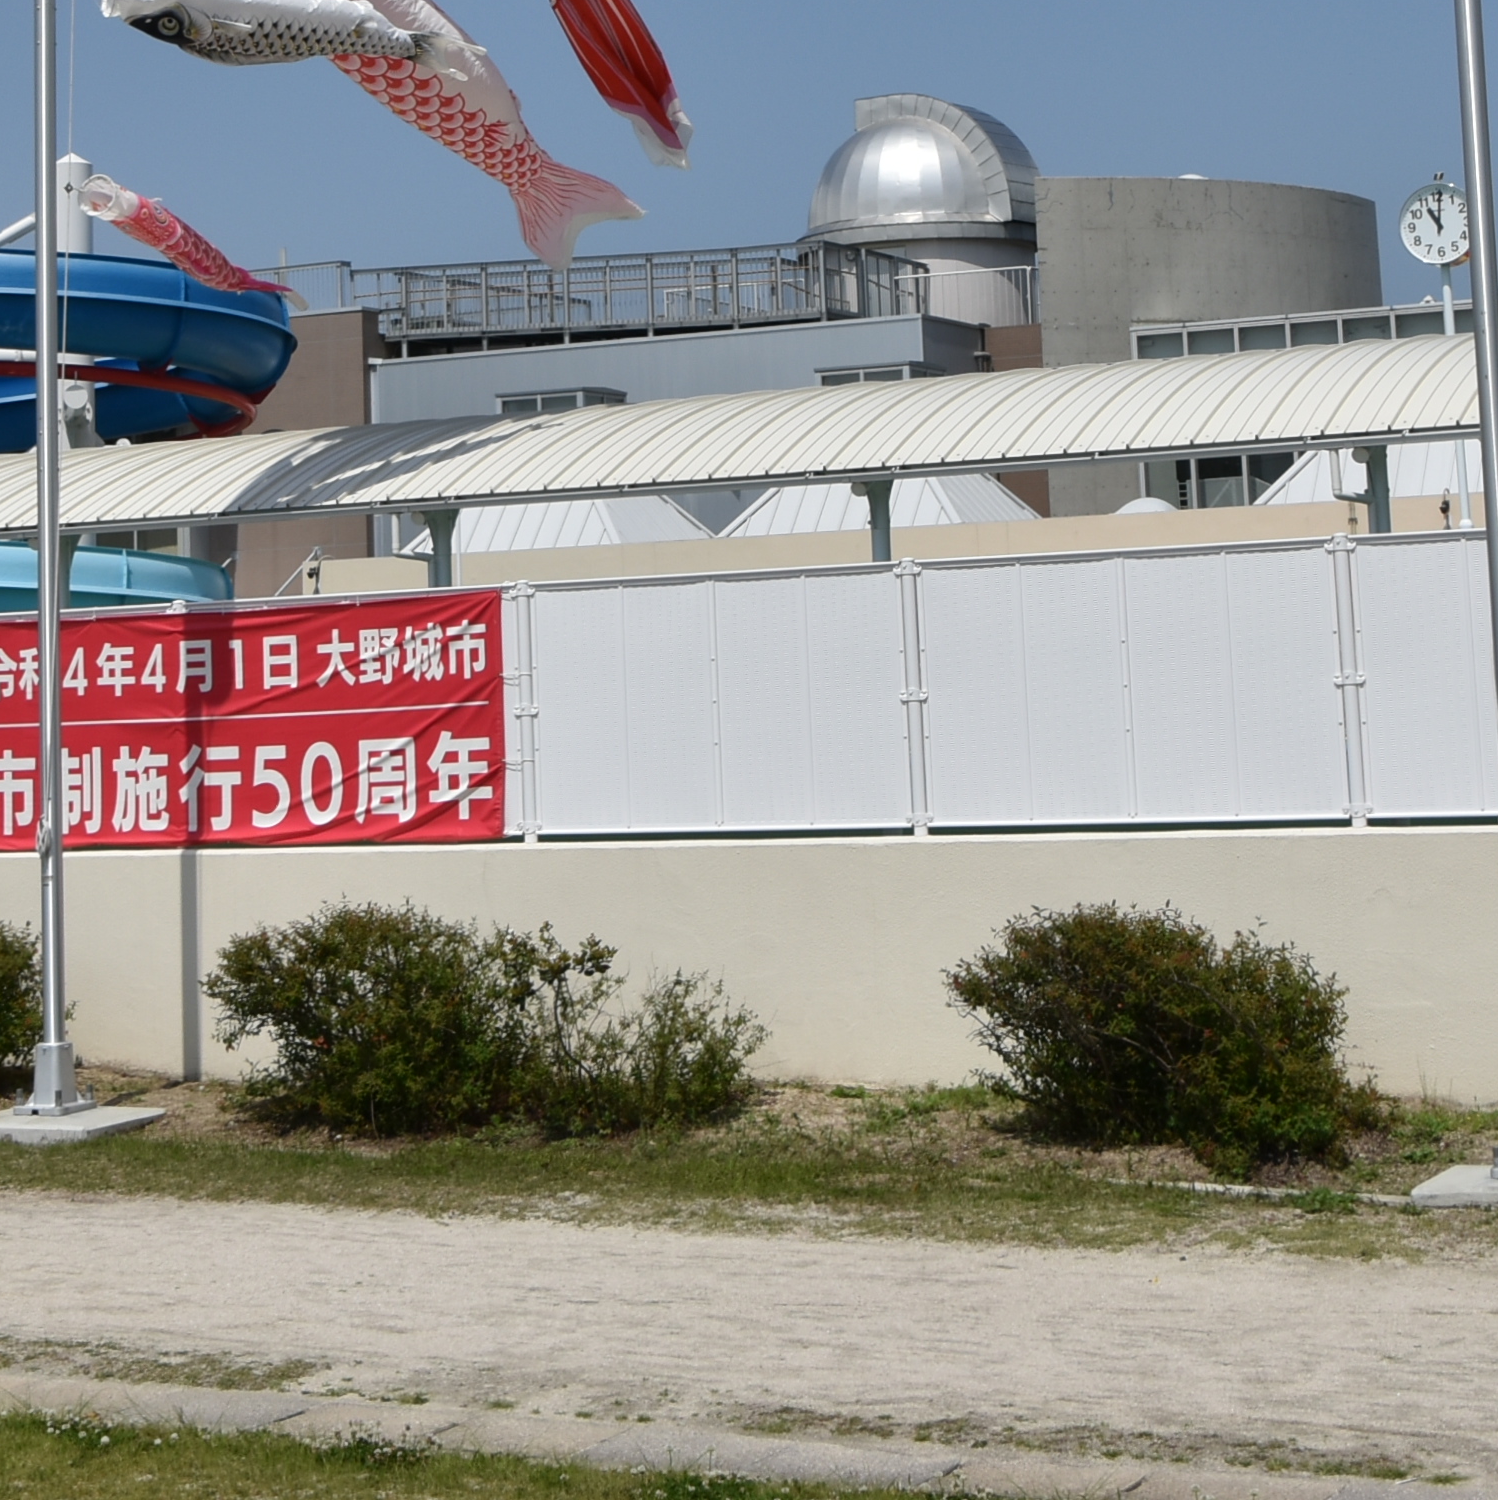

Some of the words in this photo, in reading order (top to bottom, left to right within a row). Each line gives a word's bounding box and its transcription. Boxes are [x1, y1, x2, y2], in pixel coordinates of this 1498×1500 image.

[1418, 197, 1429, 208] 11
[1458, 203, 1467, 214] 2
[1409, 209, 1423, 220] 10
[1407, 222, 1416, 233] 9
[1413, 235, 1422, 246] 8
[1460, 230, 1467, 241] 4
[1424, 244, 1433, 255] 7
[1437, 246, 1446, 258] 6
[1450, 241, 1459, 252] 5
[316, 619, 487, 687] 大野城市
